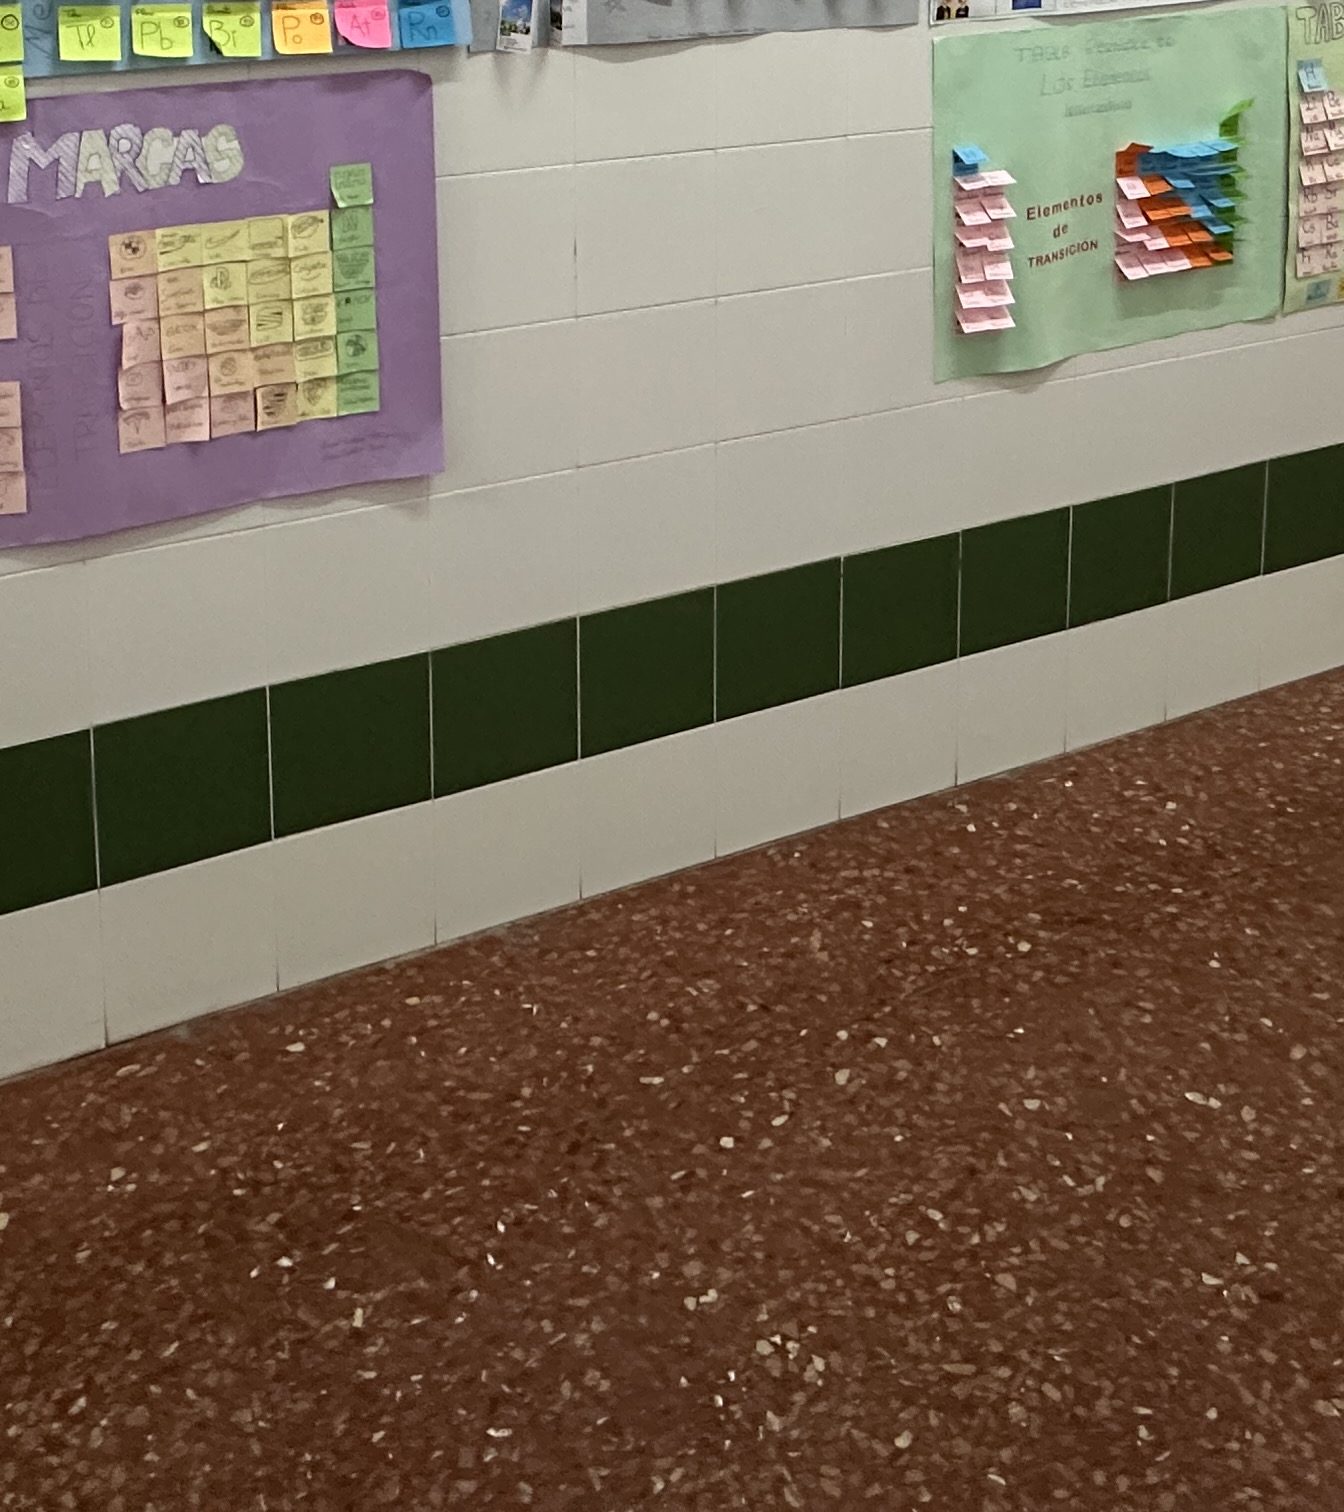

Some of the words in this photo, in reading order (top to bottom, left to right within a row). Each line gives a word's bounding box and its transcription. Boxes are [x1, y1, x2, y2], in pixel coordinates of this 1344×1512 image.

[66, 23, 96, 51] Tl
[141, 20, 174, 50] Pb
[208, 19, 237, 49] Bi
[281, 15, 304, 47] Po
[350, 14, 371, 38] At
[407, 11, 438, 42] Rn
[7, 122, 246, 204] MARCAS
[1026, 191, 1103, 220] Elementos
[1053, 222, 1069, 238] de
[1027, 239, 1099, 269] TRANSICION
